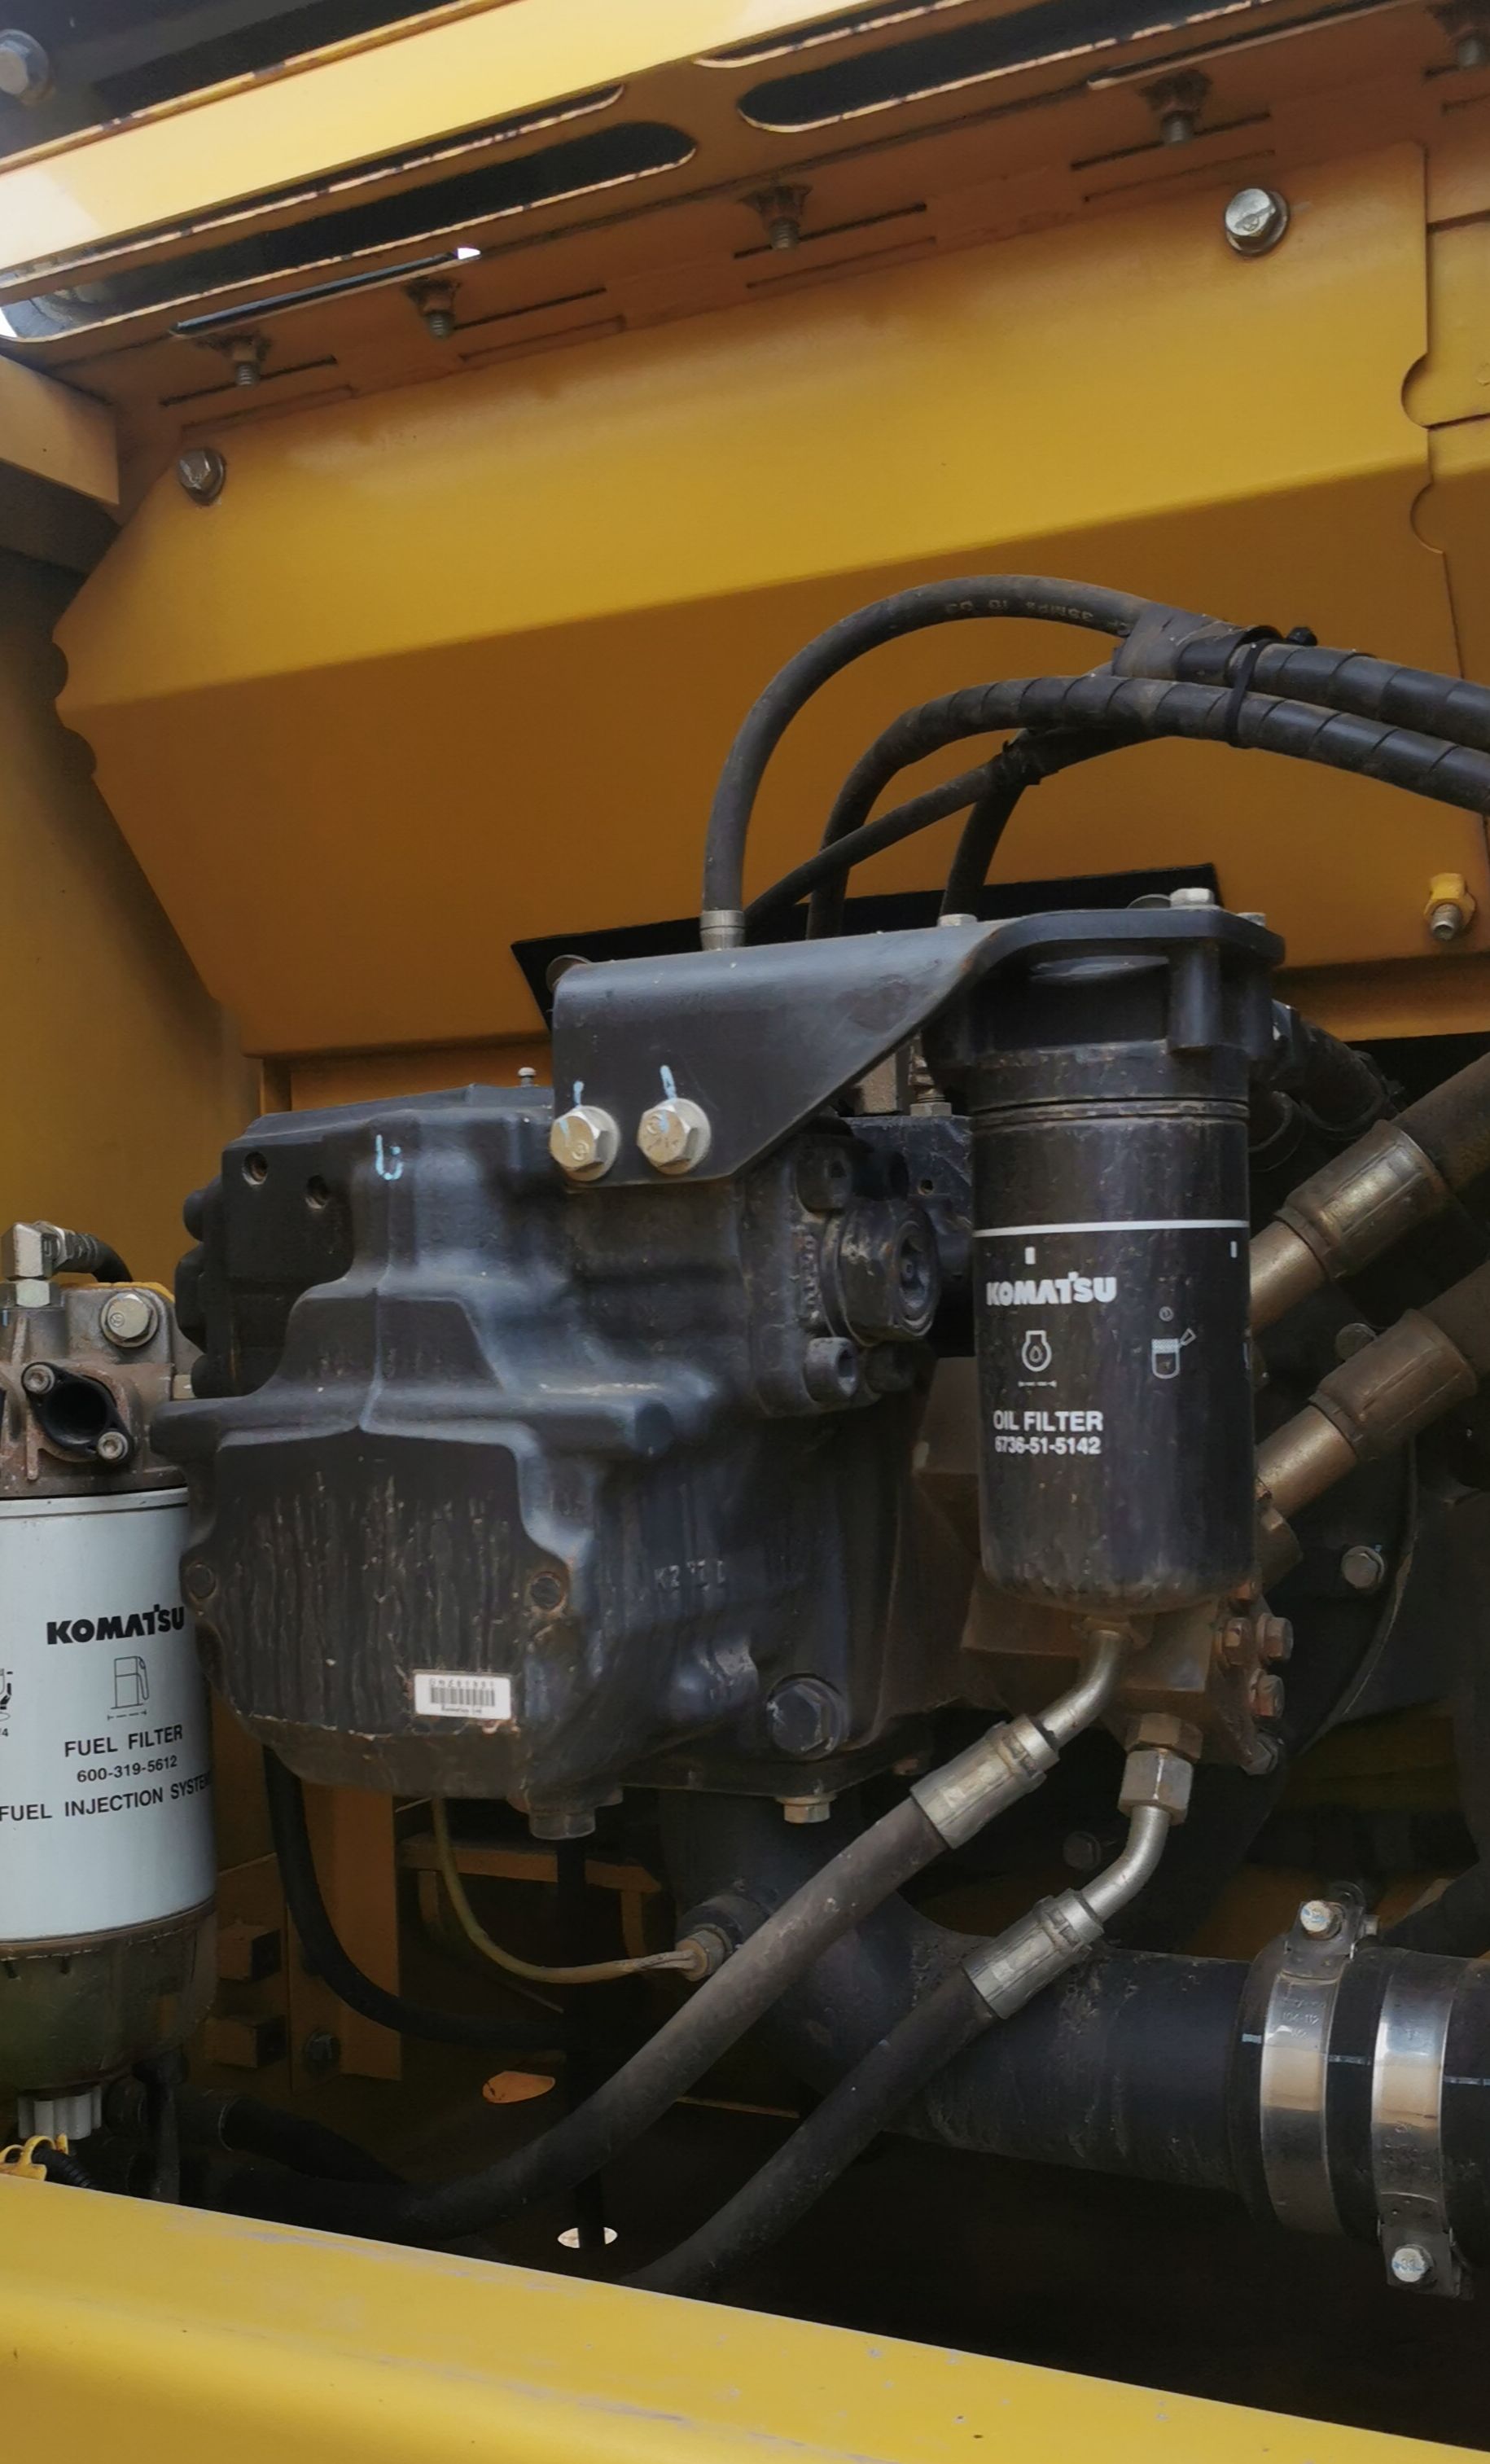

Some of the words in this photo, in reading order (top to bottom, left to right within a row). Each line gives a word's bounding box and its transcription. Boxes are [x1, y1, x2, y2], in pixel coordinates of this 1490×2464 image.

[986, 1271, 1117, 1306] KOMATSU
[993, 1410, 1019, 1431] OIL
[1023, 1410, 1103, 1432] FILTER
[995, 1436, 1102, 1456] 6736-51-5142
[46, 1604, 185, 1646] KOMATSU
[64, 1737, 118, 1758] FUEL
[128, 1724, 183, 1750] FILTER
[77, 1755, 178, 1782] 600-319-5612
[0, 1804, 53, 1822] FUEL
[64, 1787, 164, 1817] INJECTION
